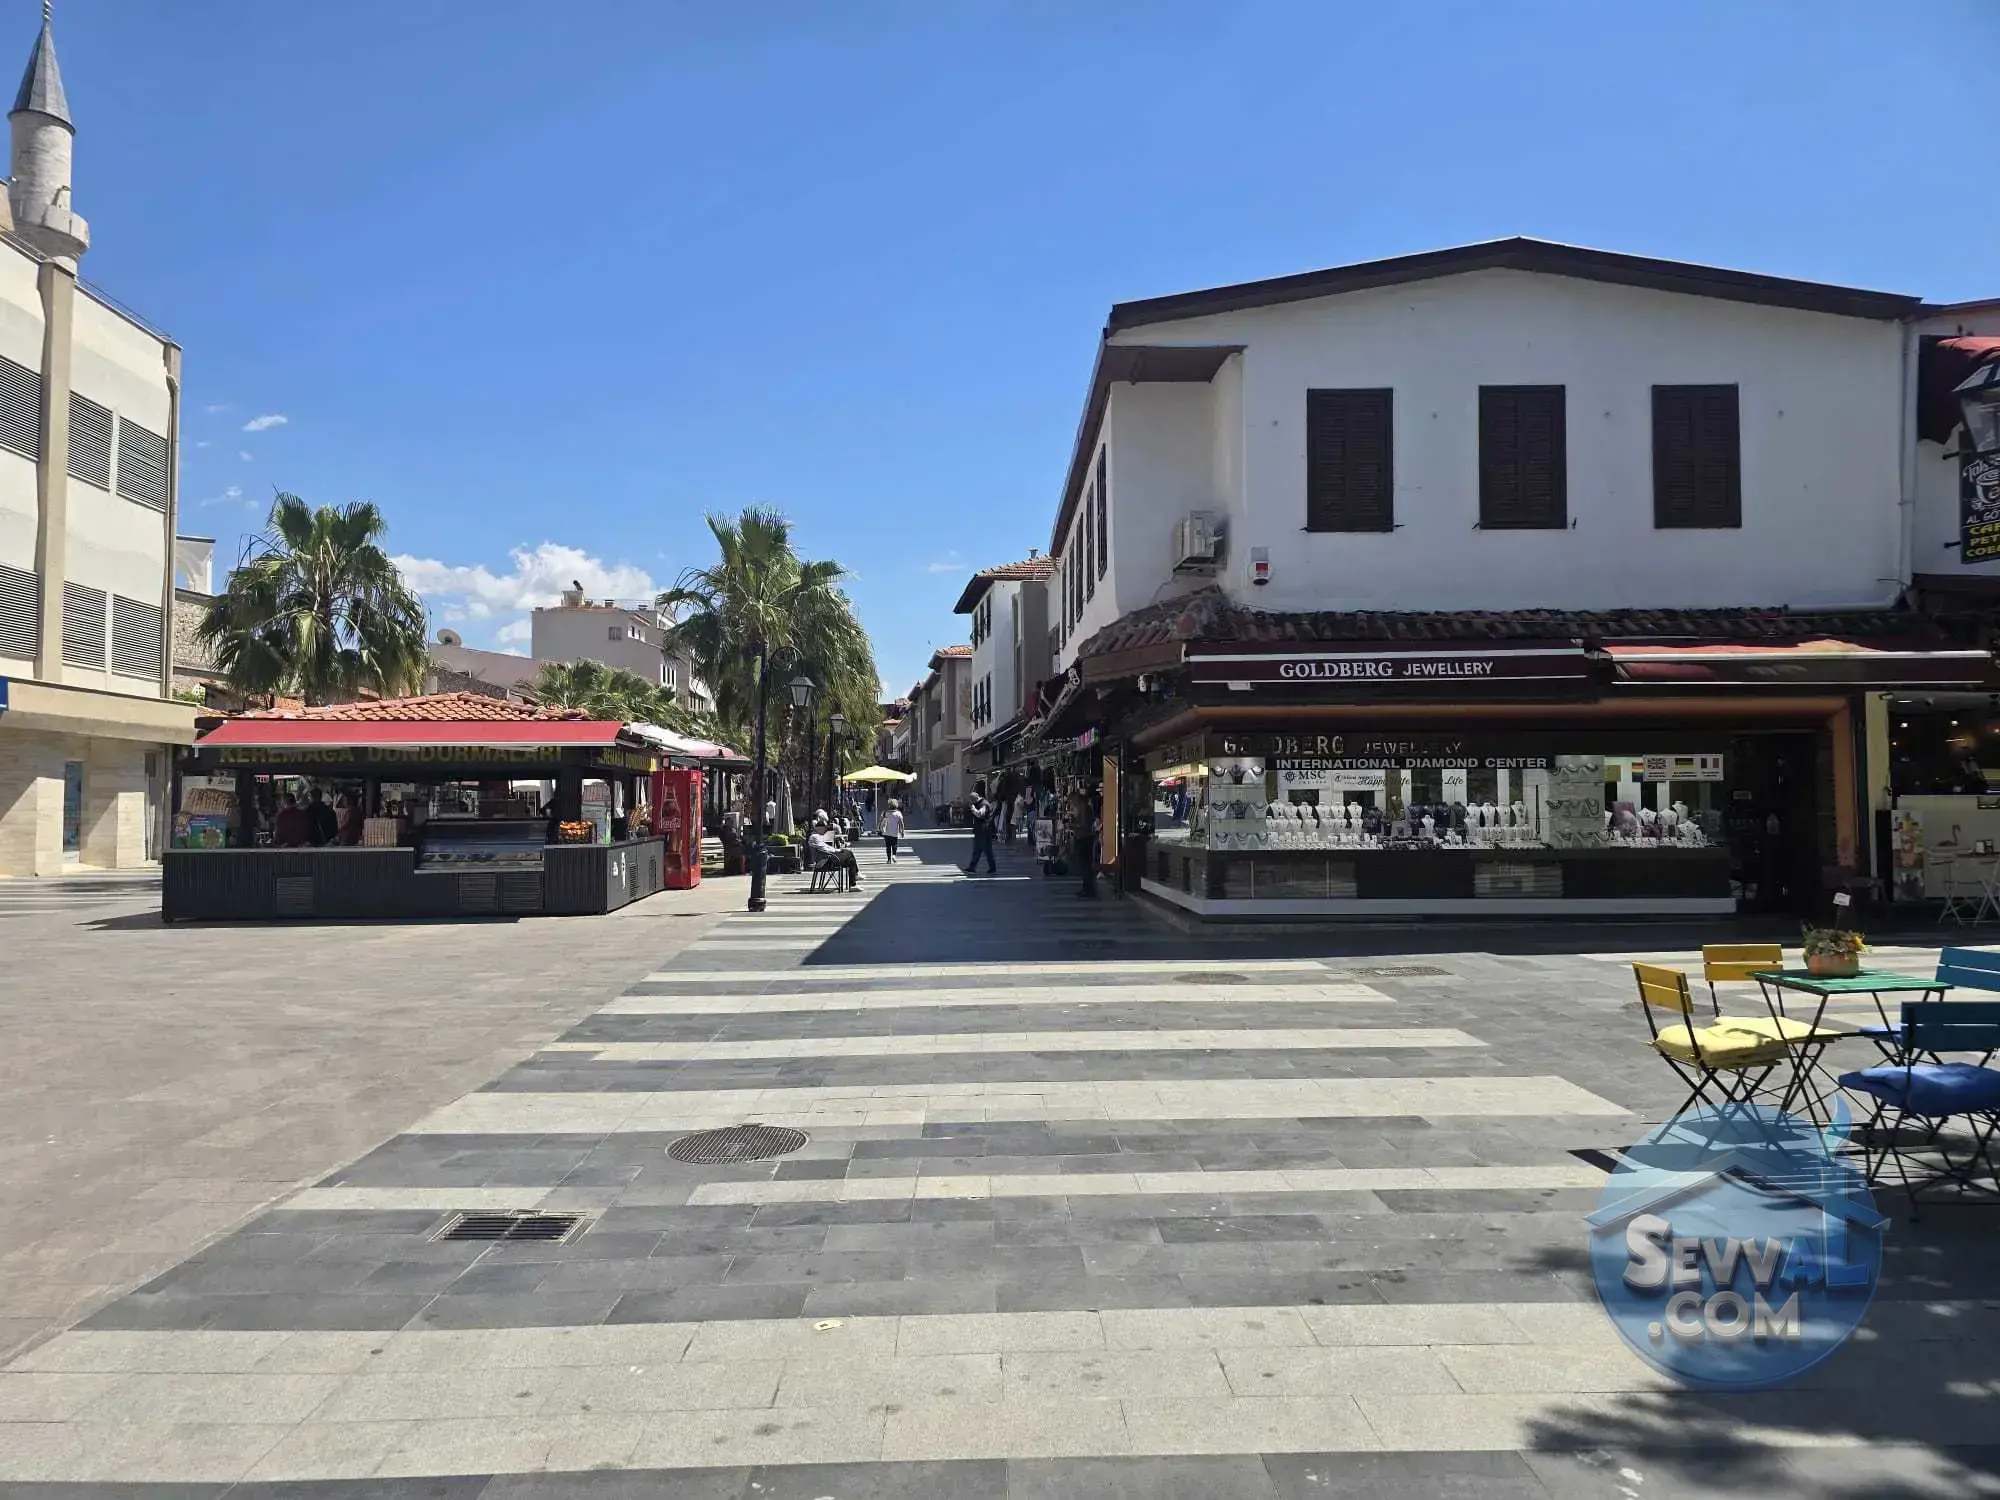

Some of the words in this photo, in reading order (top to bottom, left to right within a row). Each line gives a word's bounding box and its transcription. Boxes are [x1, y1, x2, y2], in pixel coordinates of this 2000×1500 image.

[1279, 661, 1393, 678] GOLDBERG
[1402, 661, 1494, 676] JEWELLERY
[1224, 735, 1344, 755] GDBERG
[1276, 758, 1400, 769] INTERNATIONAL
[1405, 757, 1479, 768] DIAMOND
[1485, 757, 1547, 768] CENTER
[1298, 769, 1326, 780] MSC
[1444, 775, 1465, 786] Life
